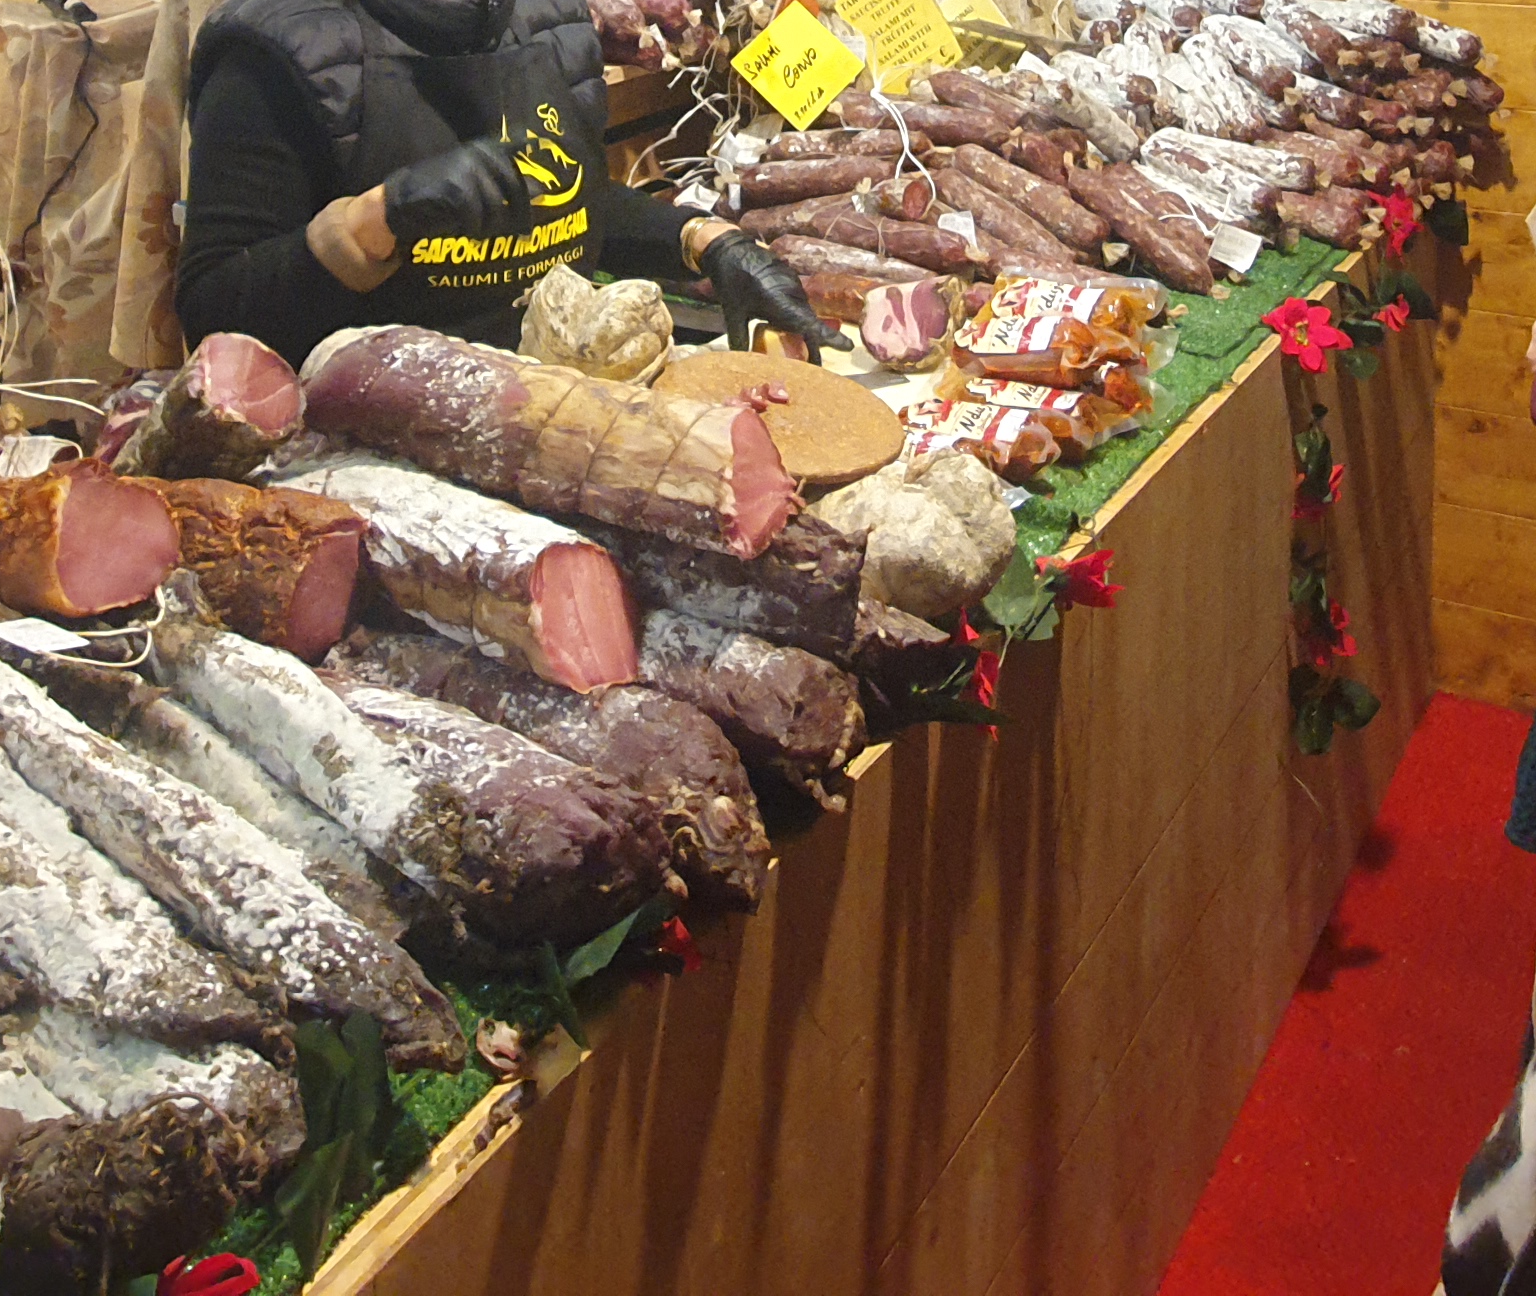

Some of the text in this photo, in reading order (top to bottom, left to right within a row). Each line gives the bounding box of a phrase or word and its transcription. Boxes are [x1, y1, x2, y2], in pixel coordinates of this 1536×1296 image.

[412, 207, 588, 264] SAPORI DI MONTAGNA
[428, 245, 584, 288] SALUMI E FORMAGGI
